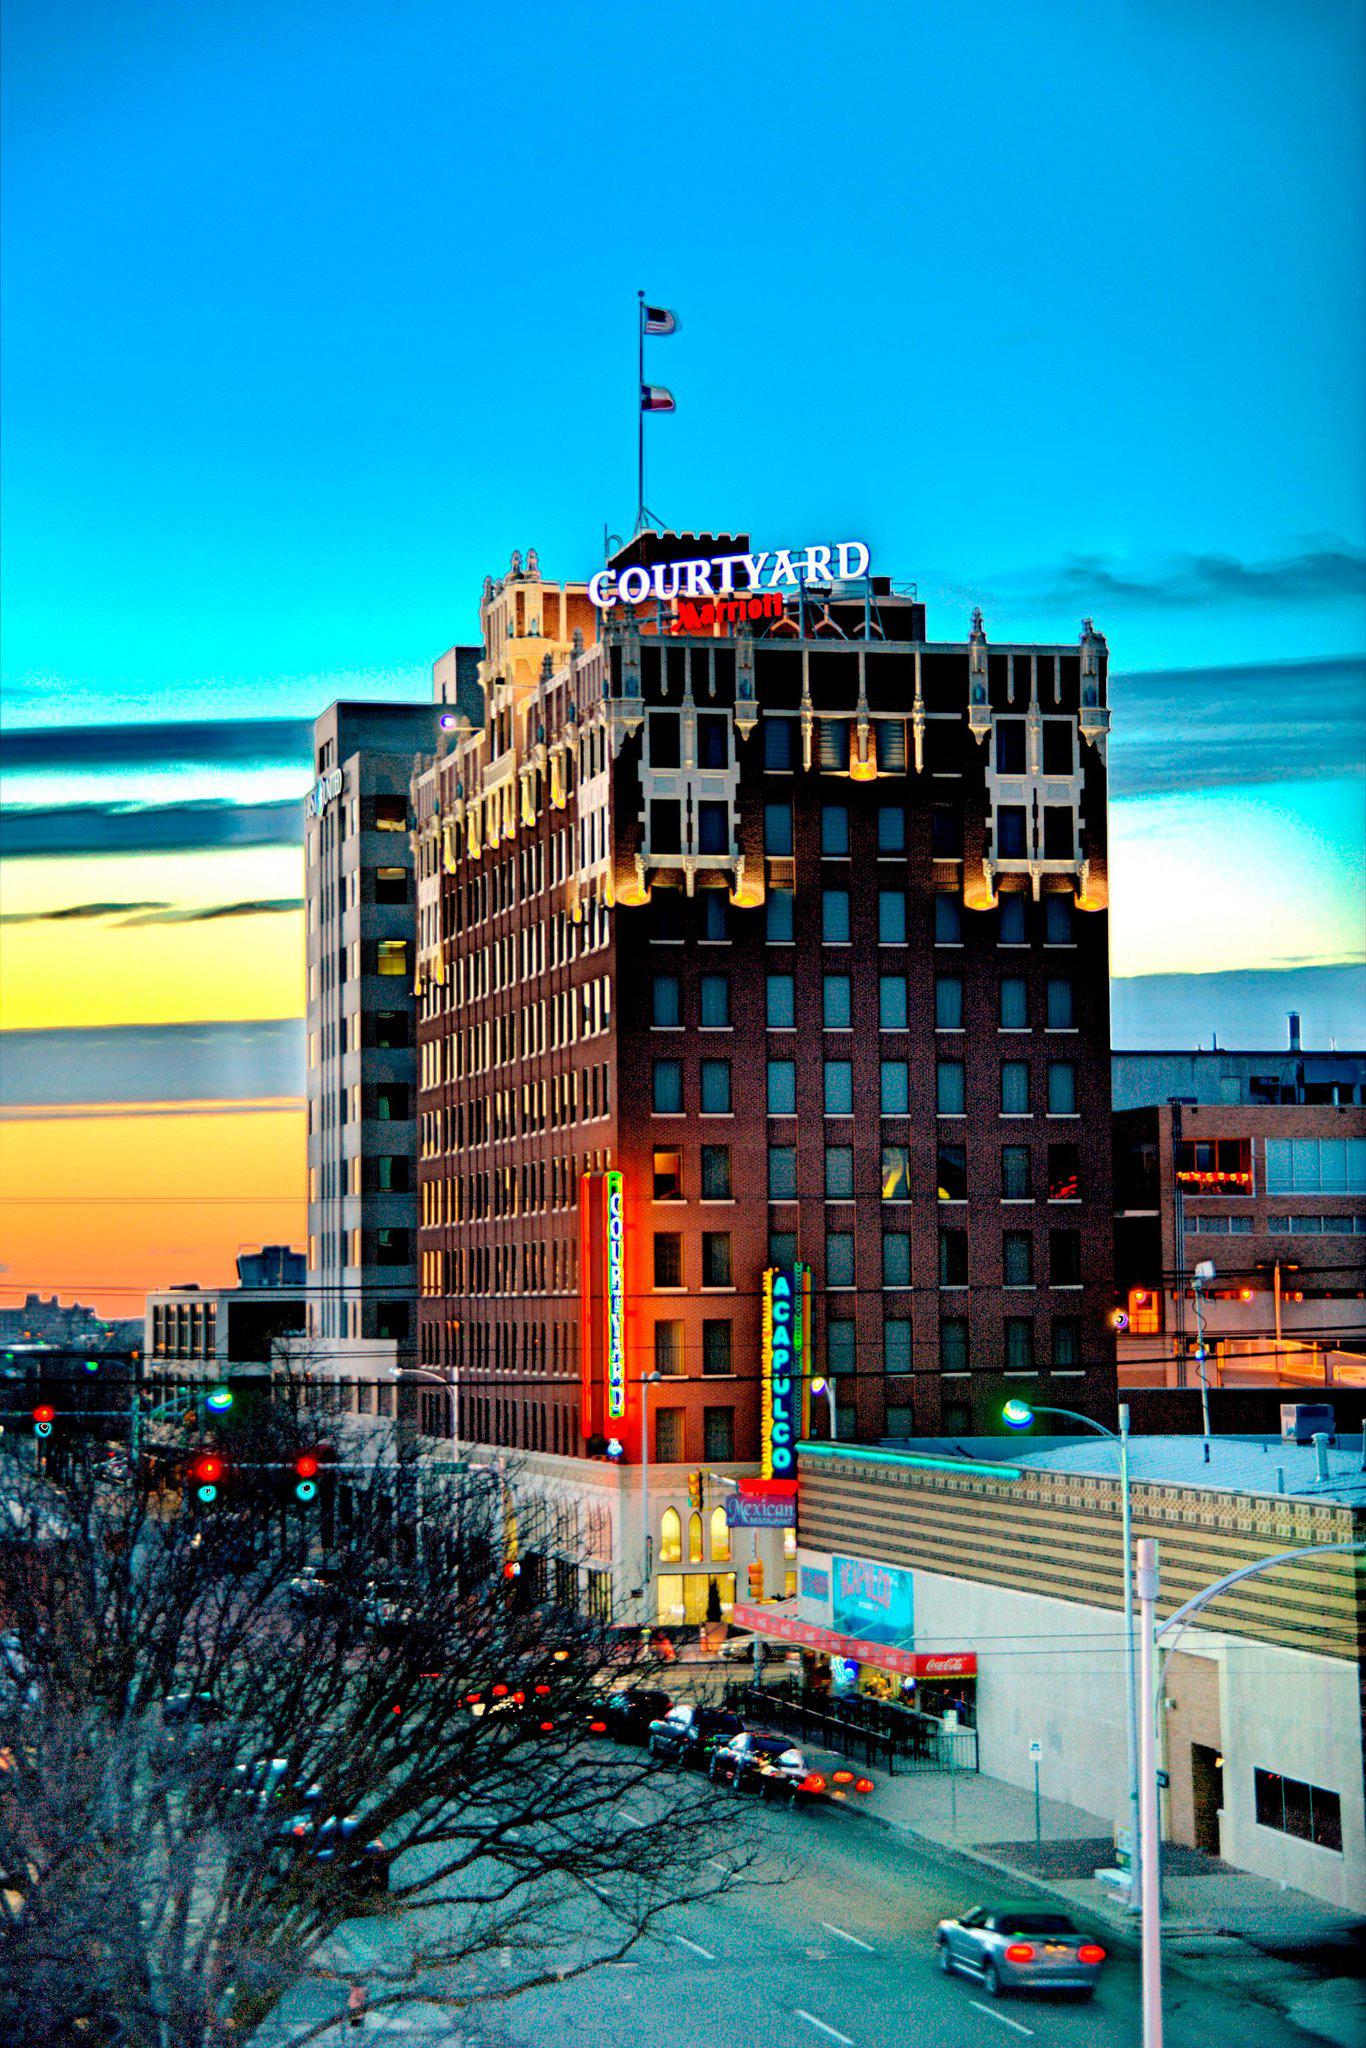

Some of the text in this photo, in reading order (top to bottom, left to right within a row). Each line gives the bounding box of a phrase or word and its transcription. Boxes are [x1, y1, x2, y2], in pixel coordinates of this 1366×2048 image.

[588, 541, 870, 608] COURTYARD
[670, 592, 783, 632] Marriott
[772, 1276, 792, 1469] ACAPULCO
[727, 1498, 793, 1523] Mexican
[926, 1656, 967, 1672] Coca-Cola
